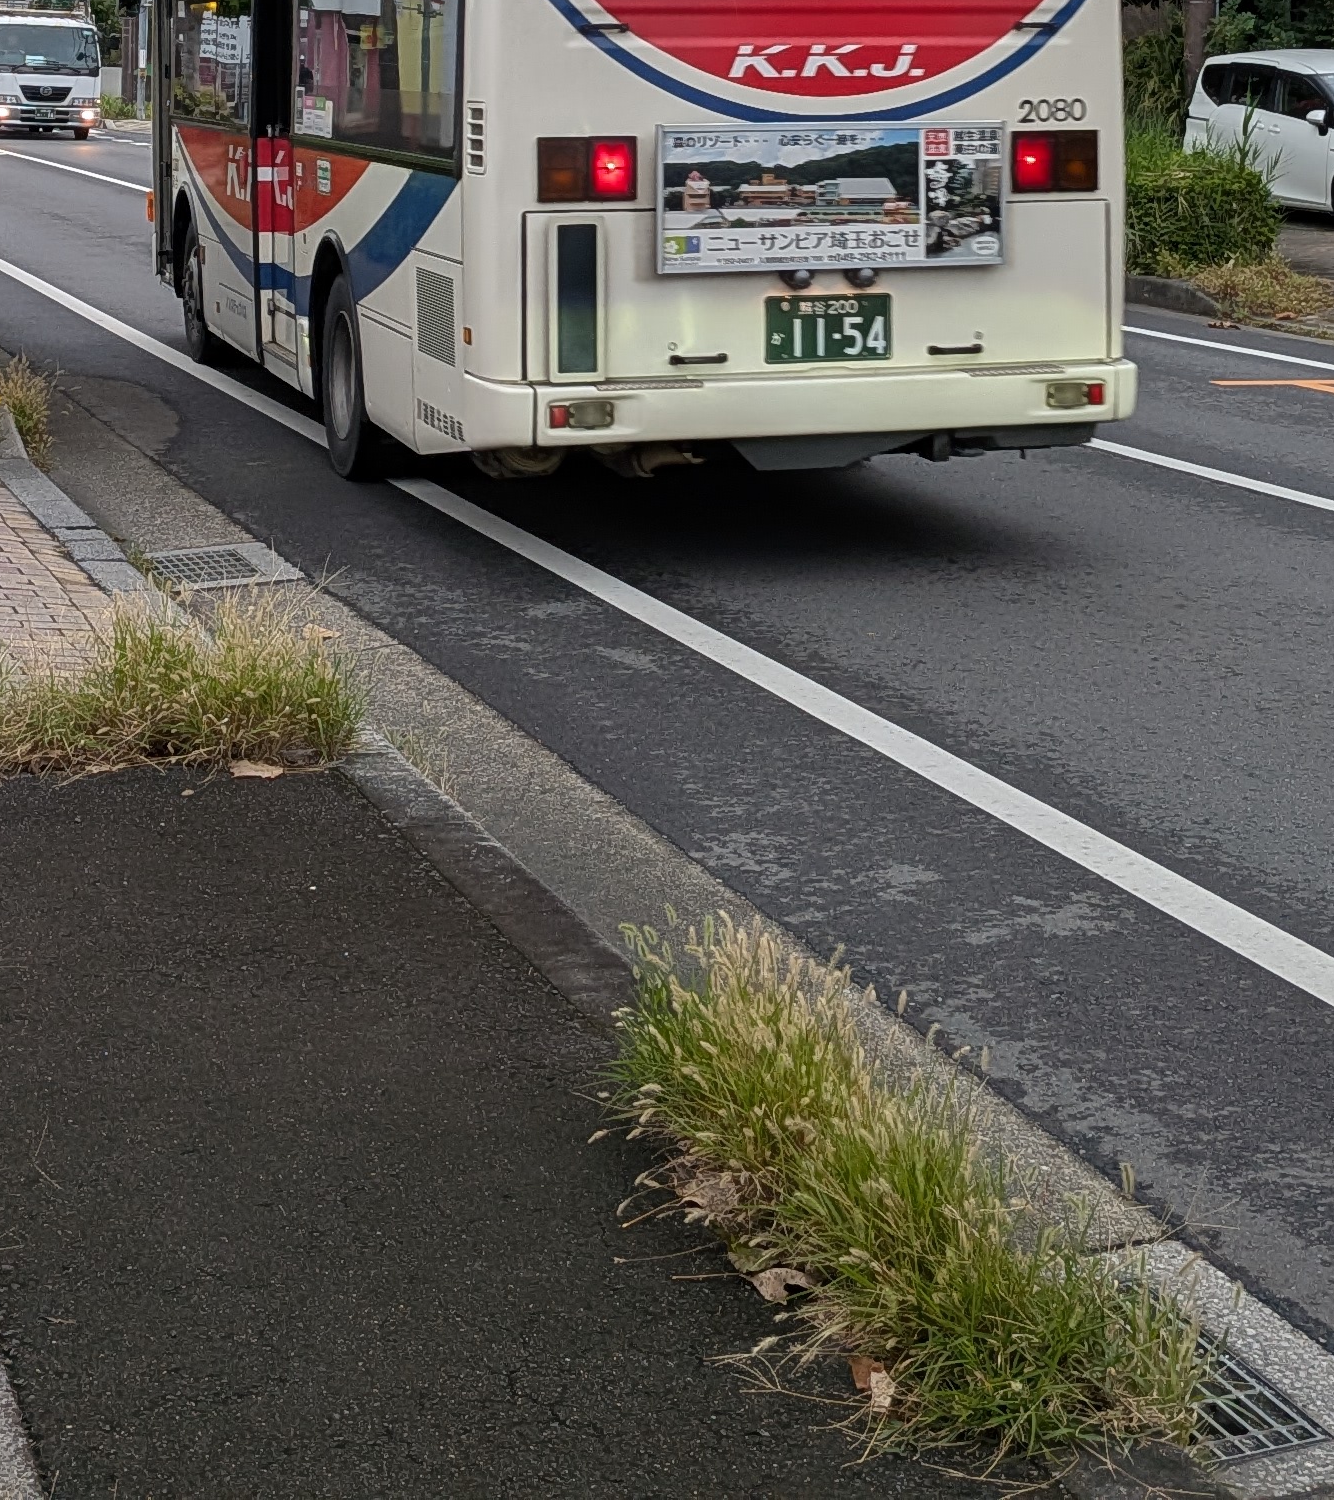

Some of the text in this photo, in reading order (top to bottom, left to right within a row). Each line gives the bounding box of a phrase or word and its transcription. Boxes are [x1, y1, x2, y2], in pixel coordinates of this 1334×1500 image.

[728, 44, 926, 78] K.K.J.
[1018, 97, 1088, 124] 2080
[707, 229, 921, 252] ニューサンピア埼玉おごせ
[792, 315, 887, 358] 11-54
